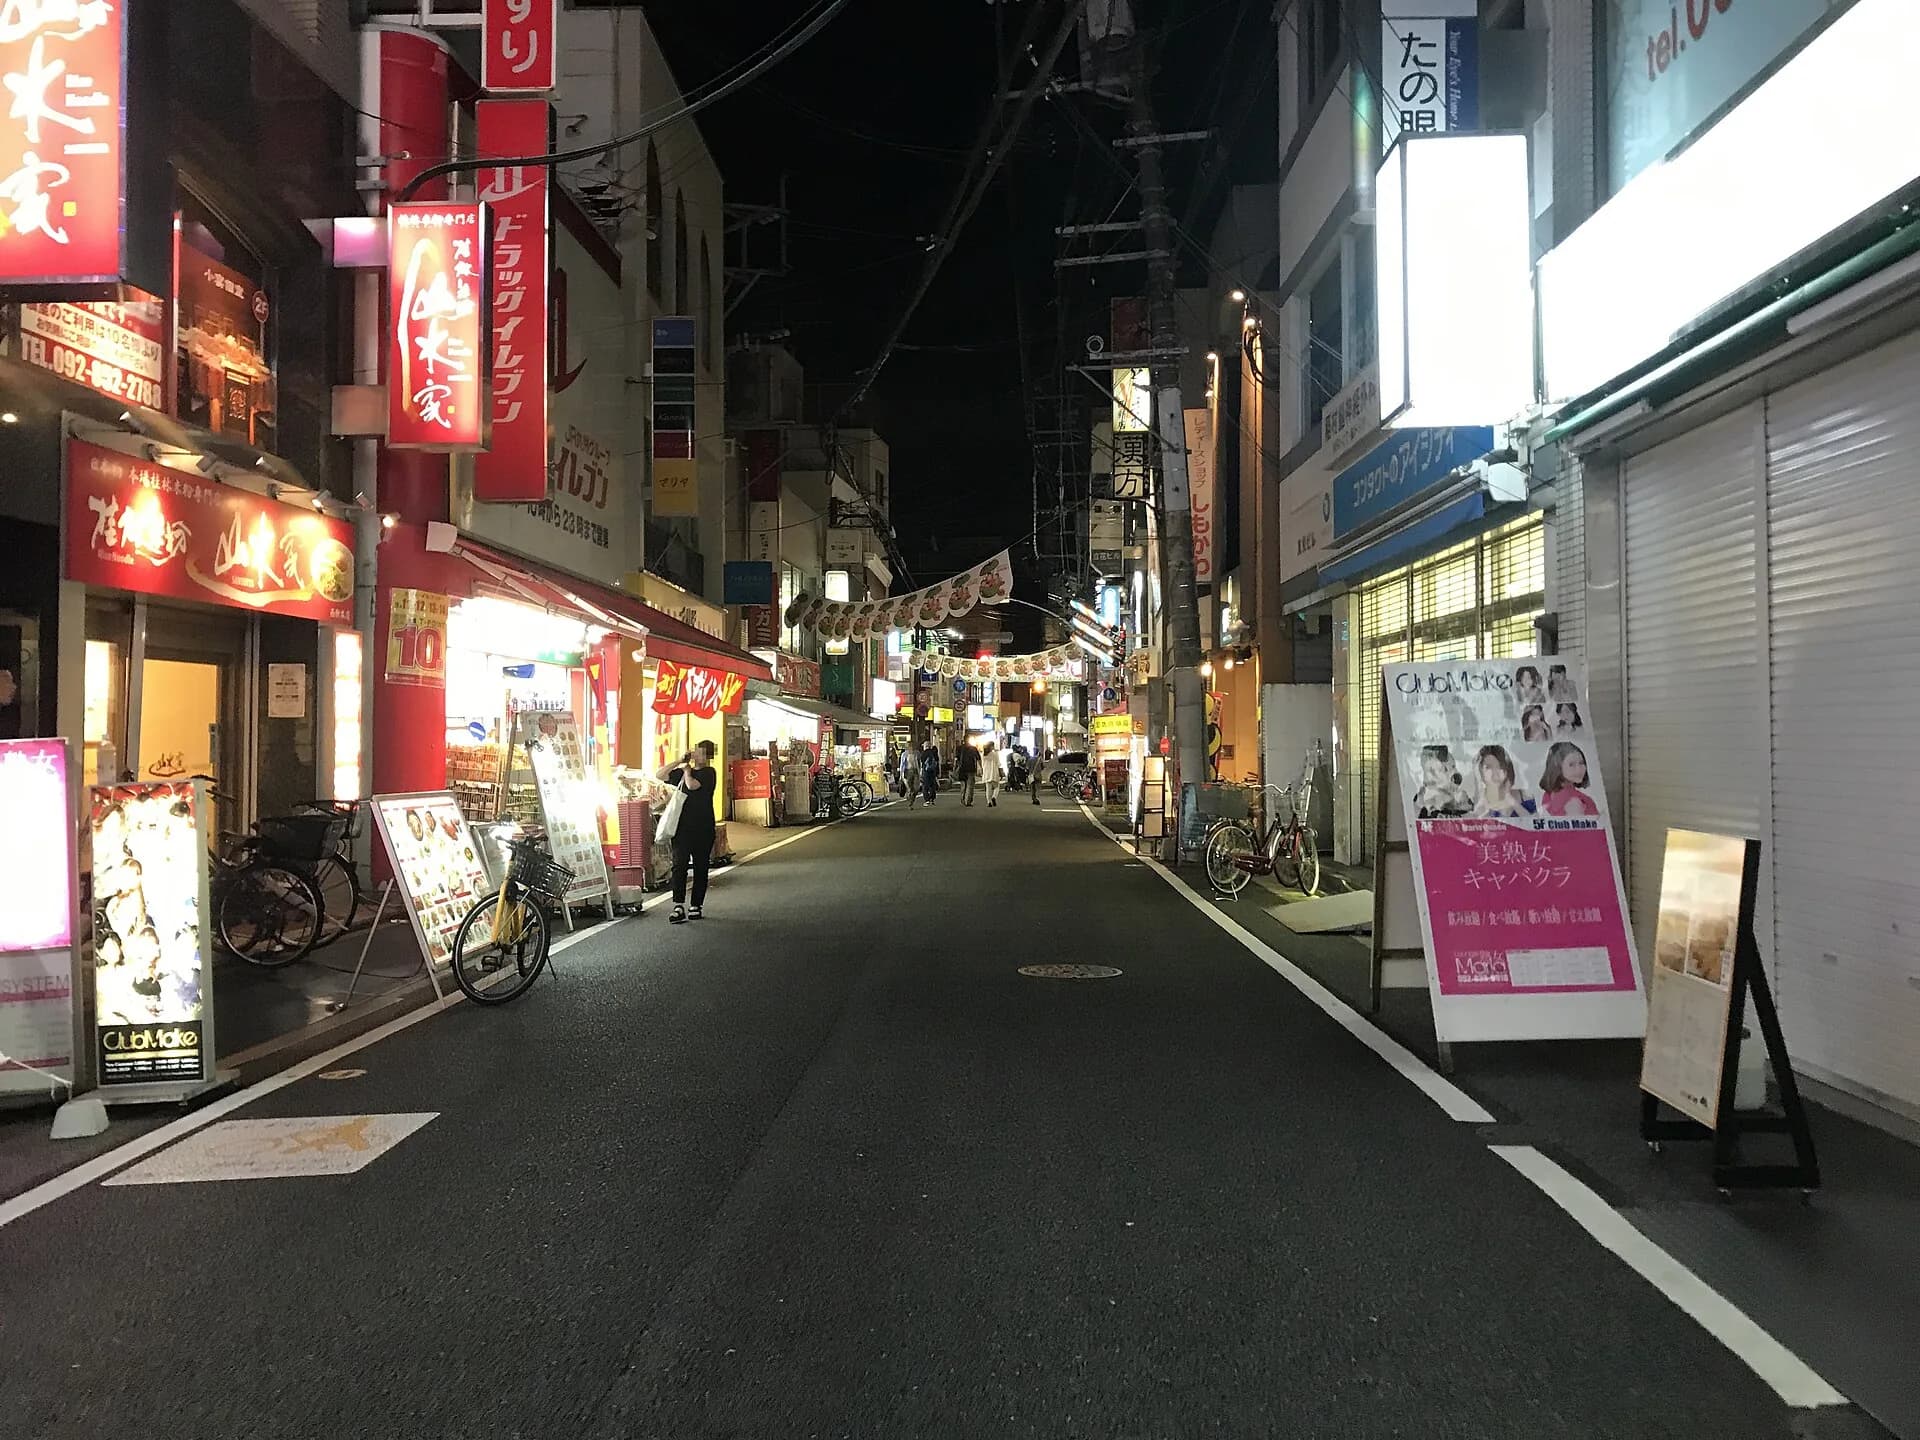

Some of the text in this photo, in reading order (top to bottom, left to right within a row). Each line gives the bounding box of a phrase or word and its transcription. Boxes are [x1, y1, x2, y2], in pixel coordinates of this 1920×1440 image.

[491, 213, 530, 424] ドラッグイレブン
[1114, 436, 1145, 497] 漢方
[1533, 819, 1598, 830] 5F Club Make
[1476, 840, 1553, 865] 美熟女
[1463, 866, 1572, 890] キャバクラ
